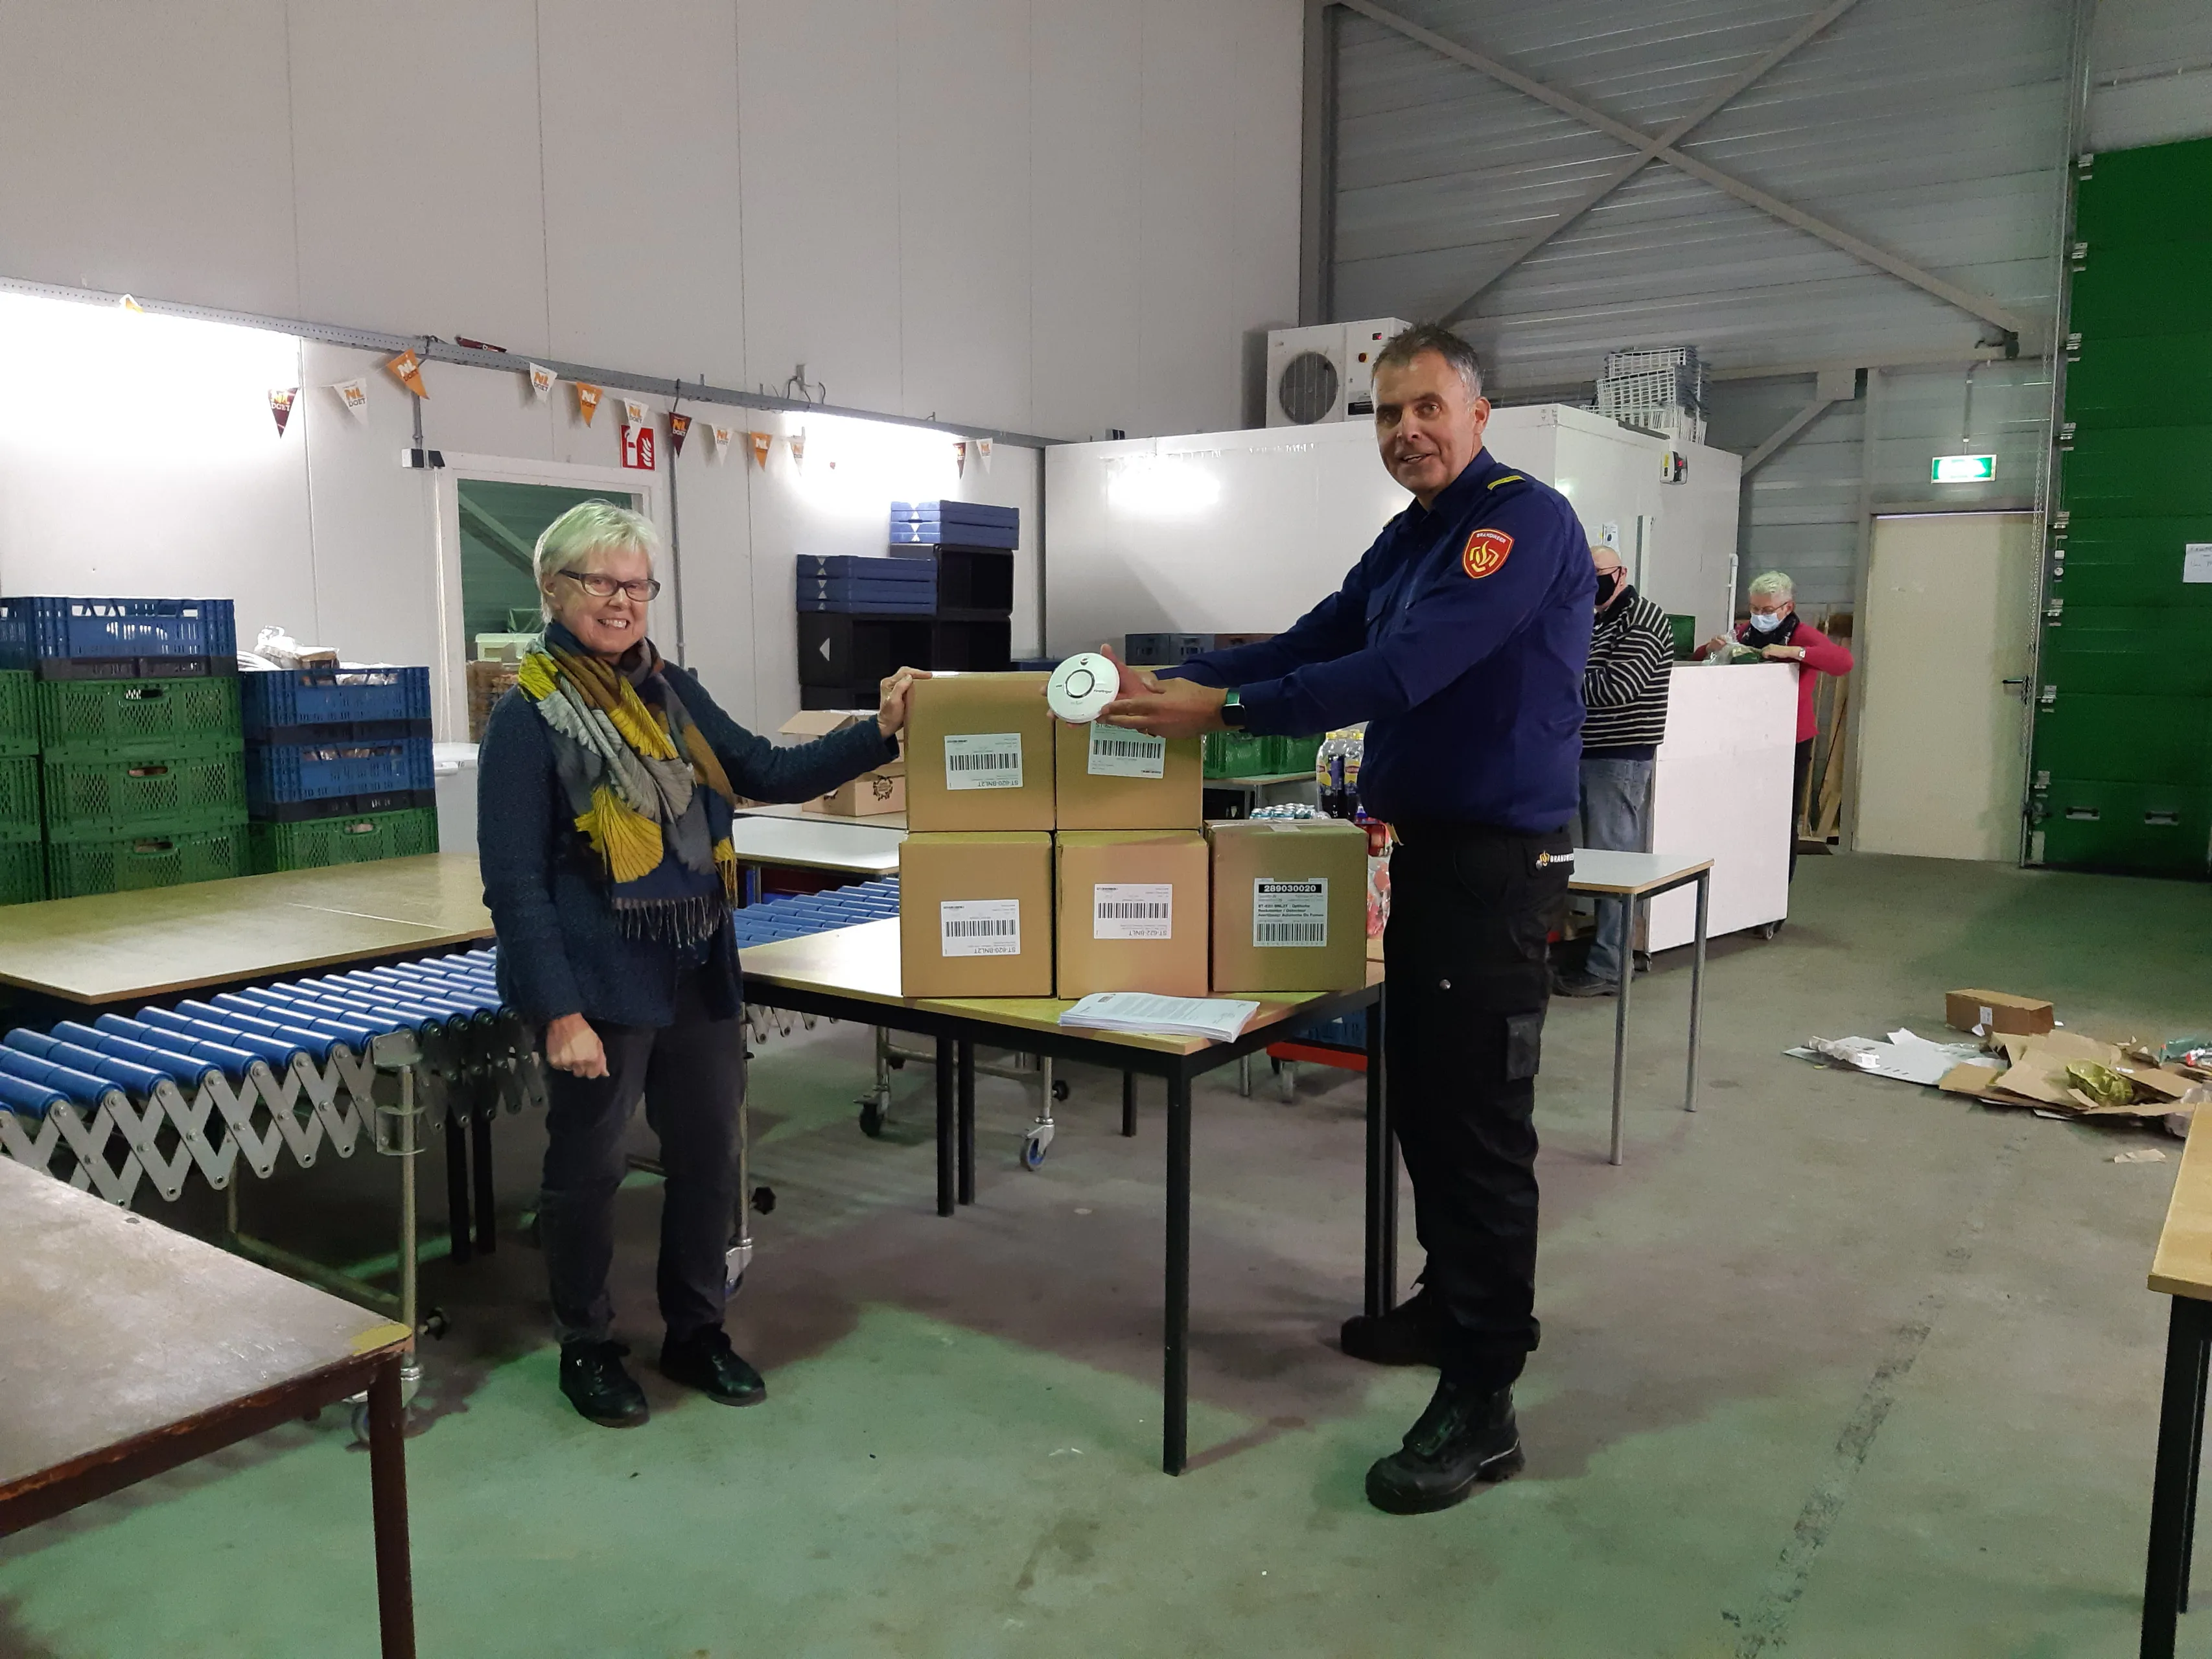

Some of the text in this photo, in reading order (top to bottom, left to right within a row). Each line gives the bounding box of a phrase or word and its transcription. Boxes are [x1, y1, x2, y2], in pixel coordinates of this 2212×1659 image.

[397, 359, 416, 377] NL
[534, 371, 549, 386] NL
[533, 382, 548, 391] DOET
[344, 387, 364, 400] NL
[581, 389, 597, 404] NL
[348, 397, 366, 408] DOET
[629, 405, 642, 418] NL
[629, 415, 642, 424] DOET
[673, 419, 687, 432] NL
[717, 430, 729, 441] NL
[756, 437, 769, 450] NL
[1476, 533, 1506, 544] BRANDWEER
